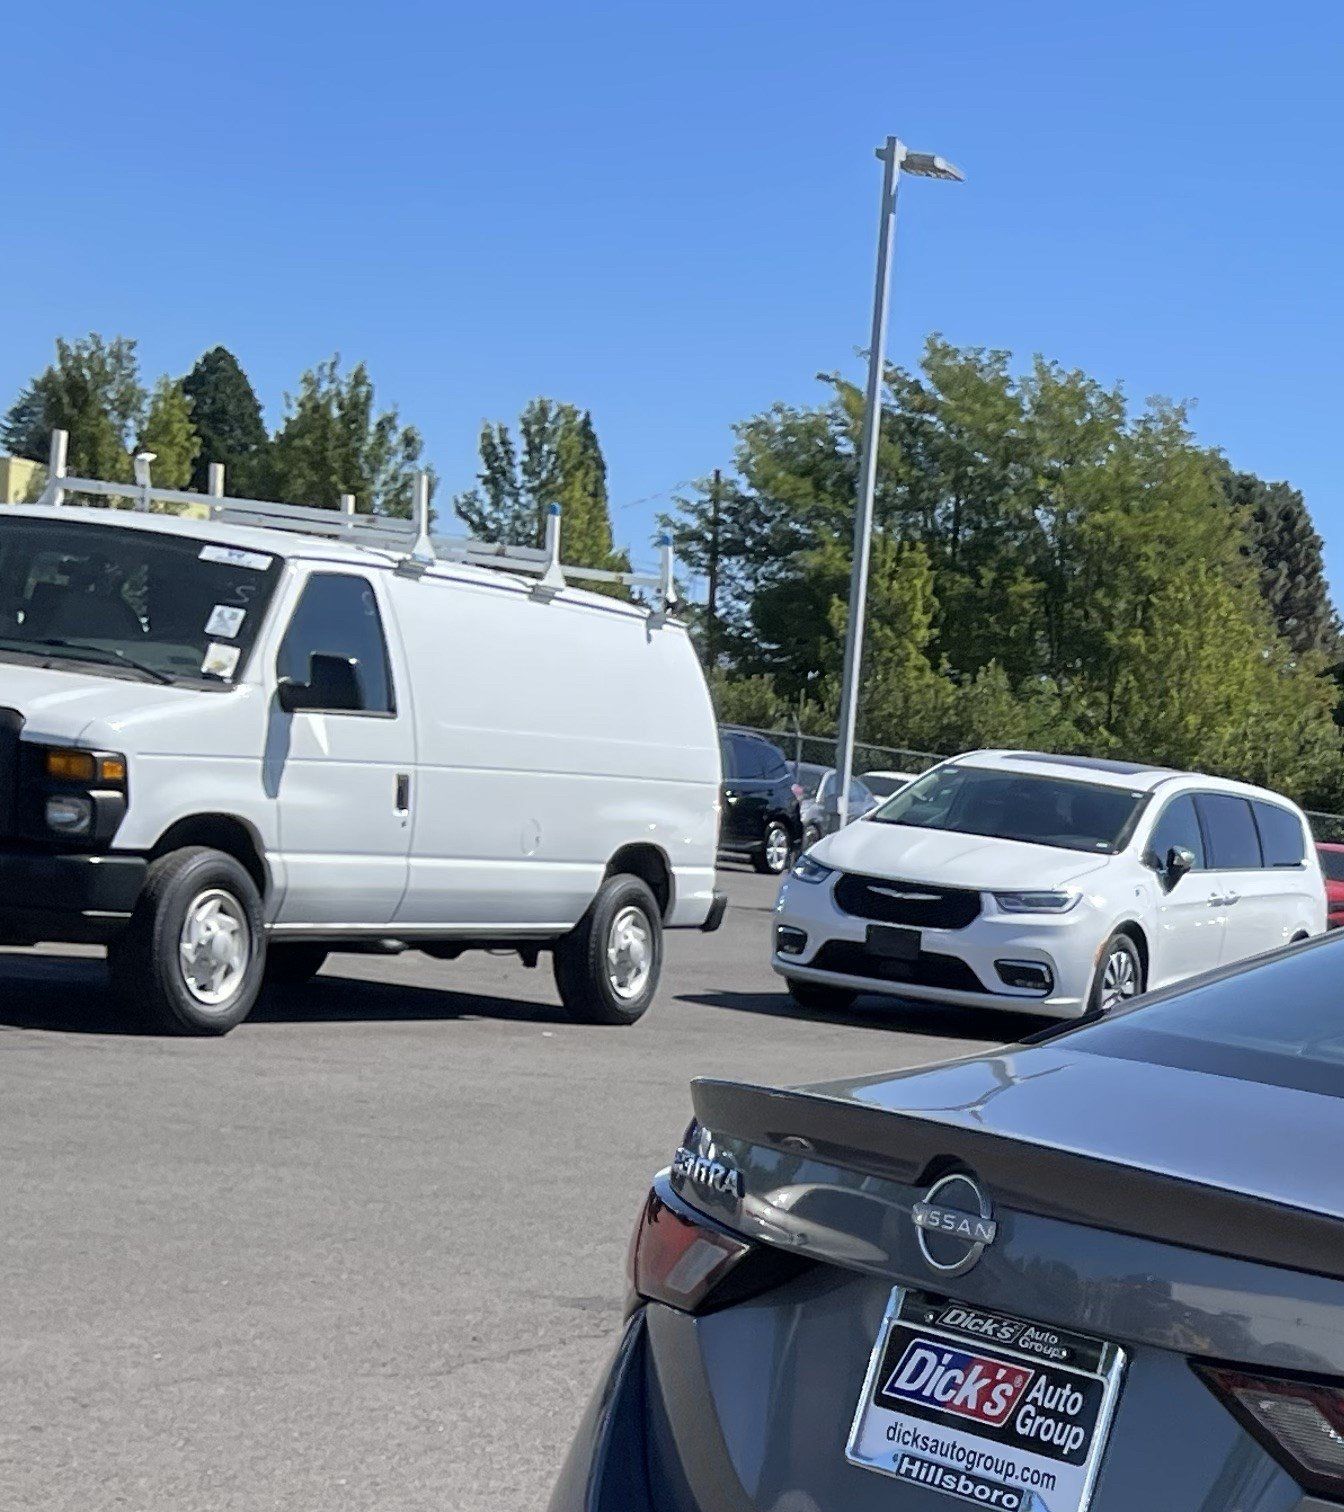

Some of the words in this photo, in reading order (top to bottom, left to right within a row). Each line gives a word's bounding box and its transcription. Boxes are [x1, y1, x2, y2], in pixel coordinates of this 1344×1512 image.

[1018, 1336, 1063, 1359] Group
[1024, 1326, 1059, 1345] Auto
[1026, 1375, 1083, 1415] Auto
[1015, 1406, 1085, 1454] Group
[886, 1421, 1057, 1491] dicksautogroup.com
[899, 1459, 1020, 1509] Hillsboro
